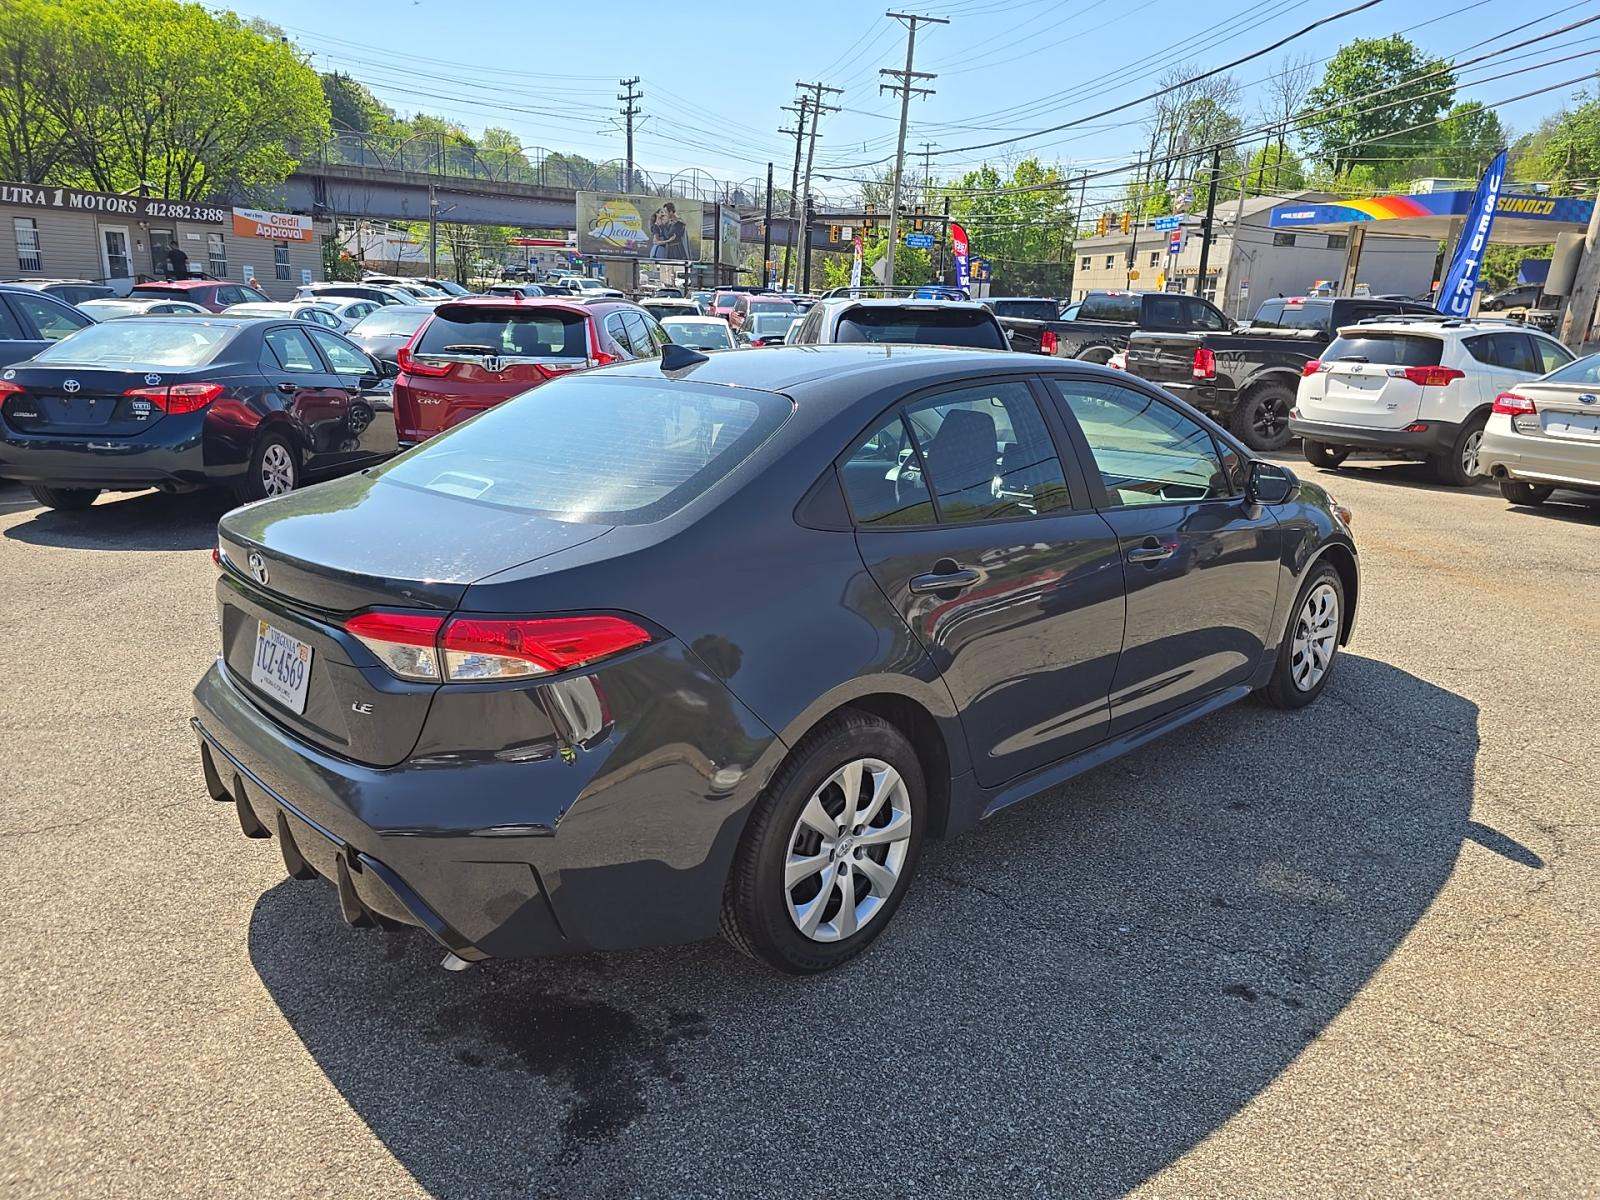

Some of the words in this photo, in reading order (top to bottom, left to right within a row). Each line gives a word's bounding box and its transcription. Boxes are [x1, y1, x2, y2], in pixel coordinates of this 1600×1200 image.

[52, 189, 64, 207] 1
[69, 193, 138, 214] MOTORS
[1496, 198, 1556, 215] SUNOCO
[270, 214, 299, 227] Credit
[1471, 174, 1501, 252] USED
[256, 223, 303, 240] Approval
[1451, 258, 1479, 314] TRU
[352, 699, 374, 715] LE
